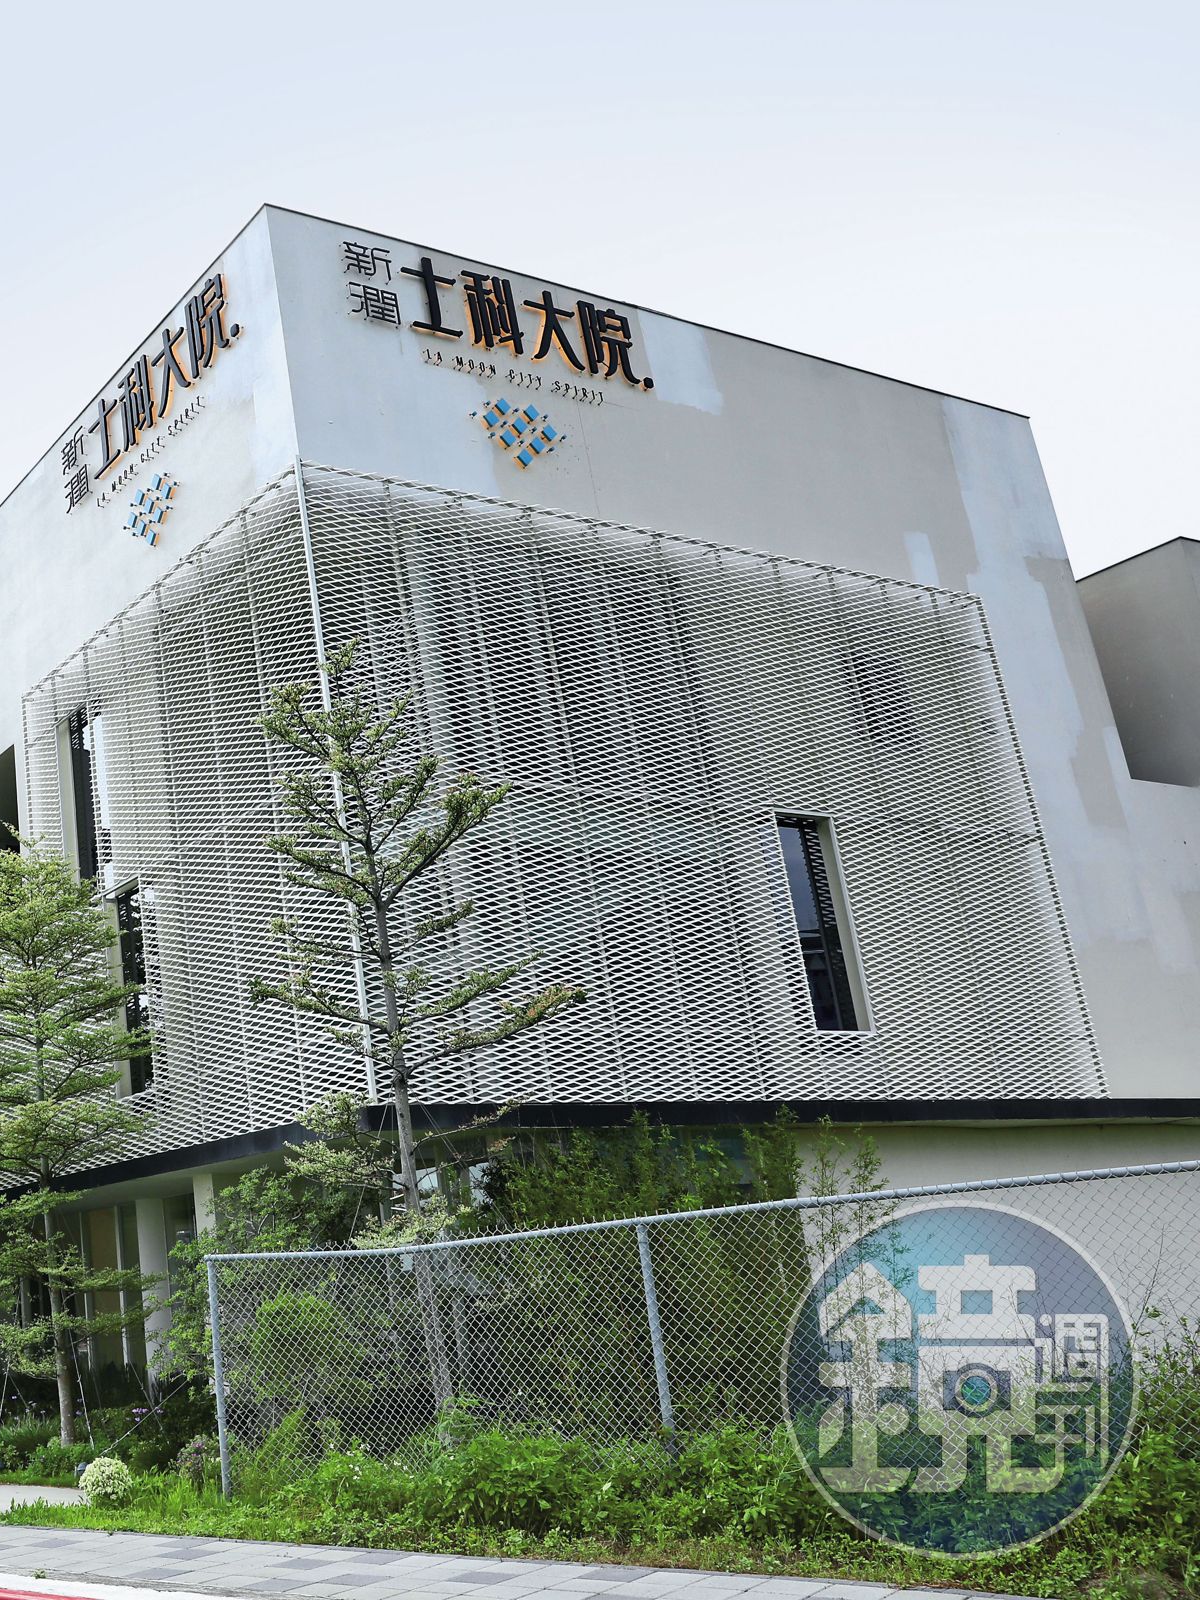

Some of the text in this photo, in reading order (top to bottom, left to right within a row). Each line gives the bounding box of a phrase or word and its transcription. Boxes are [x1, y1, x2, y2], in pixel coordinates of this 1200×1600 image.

[454, 355, 497, 378] MOON
[508, 369, 543, 390] CITY
[552, 381, 605, 405] SPIRIT
